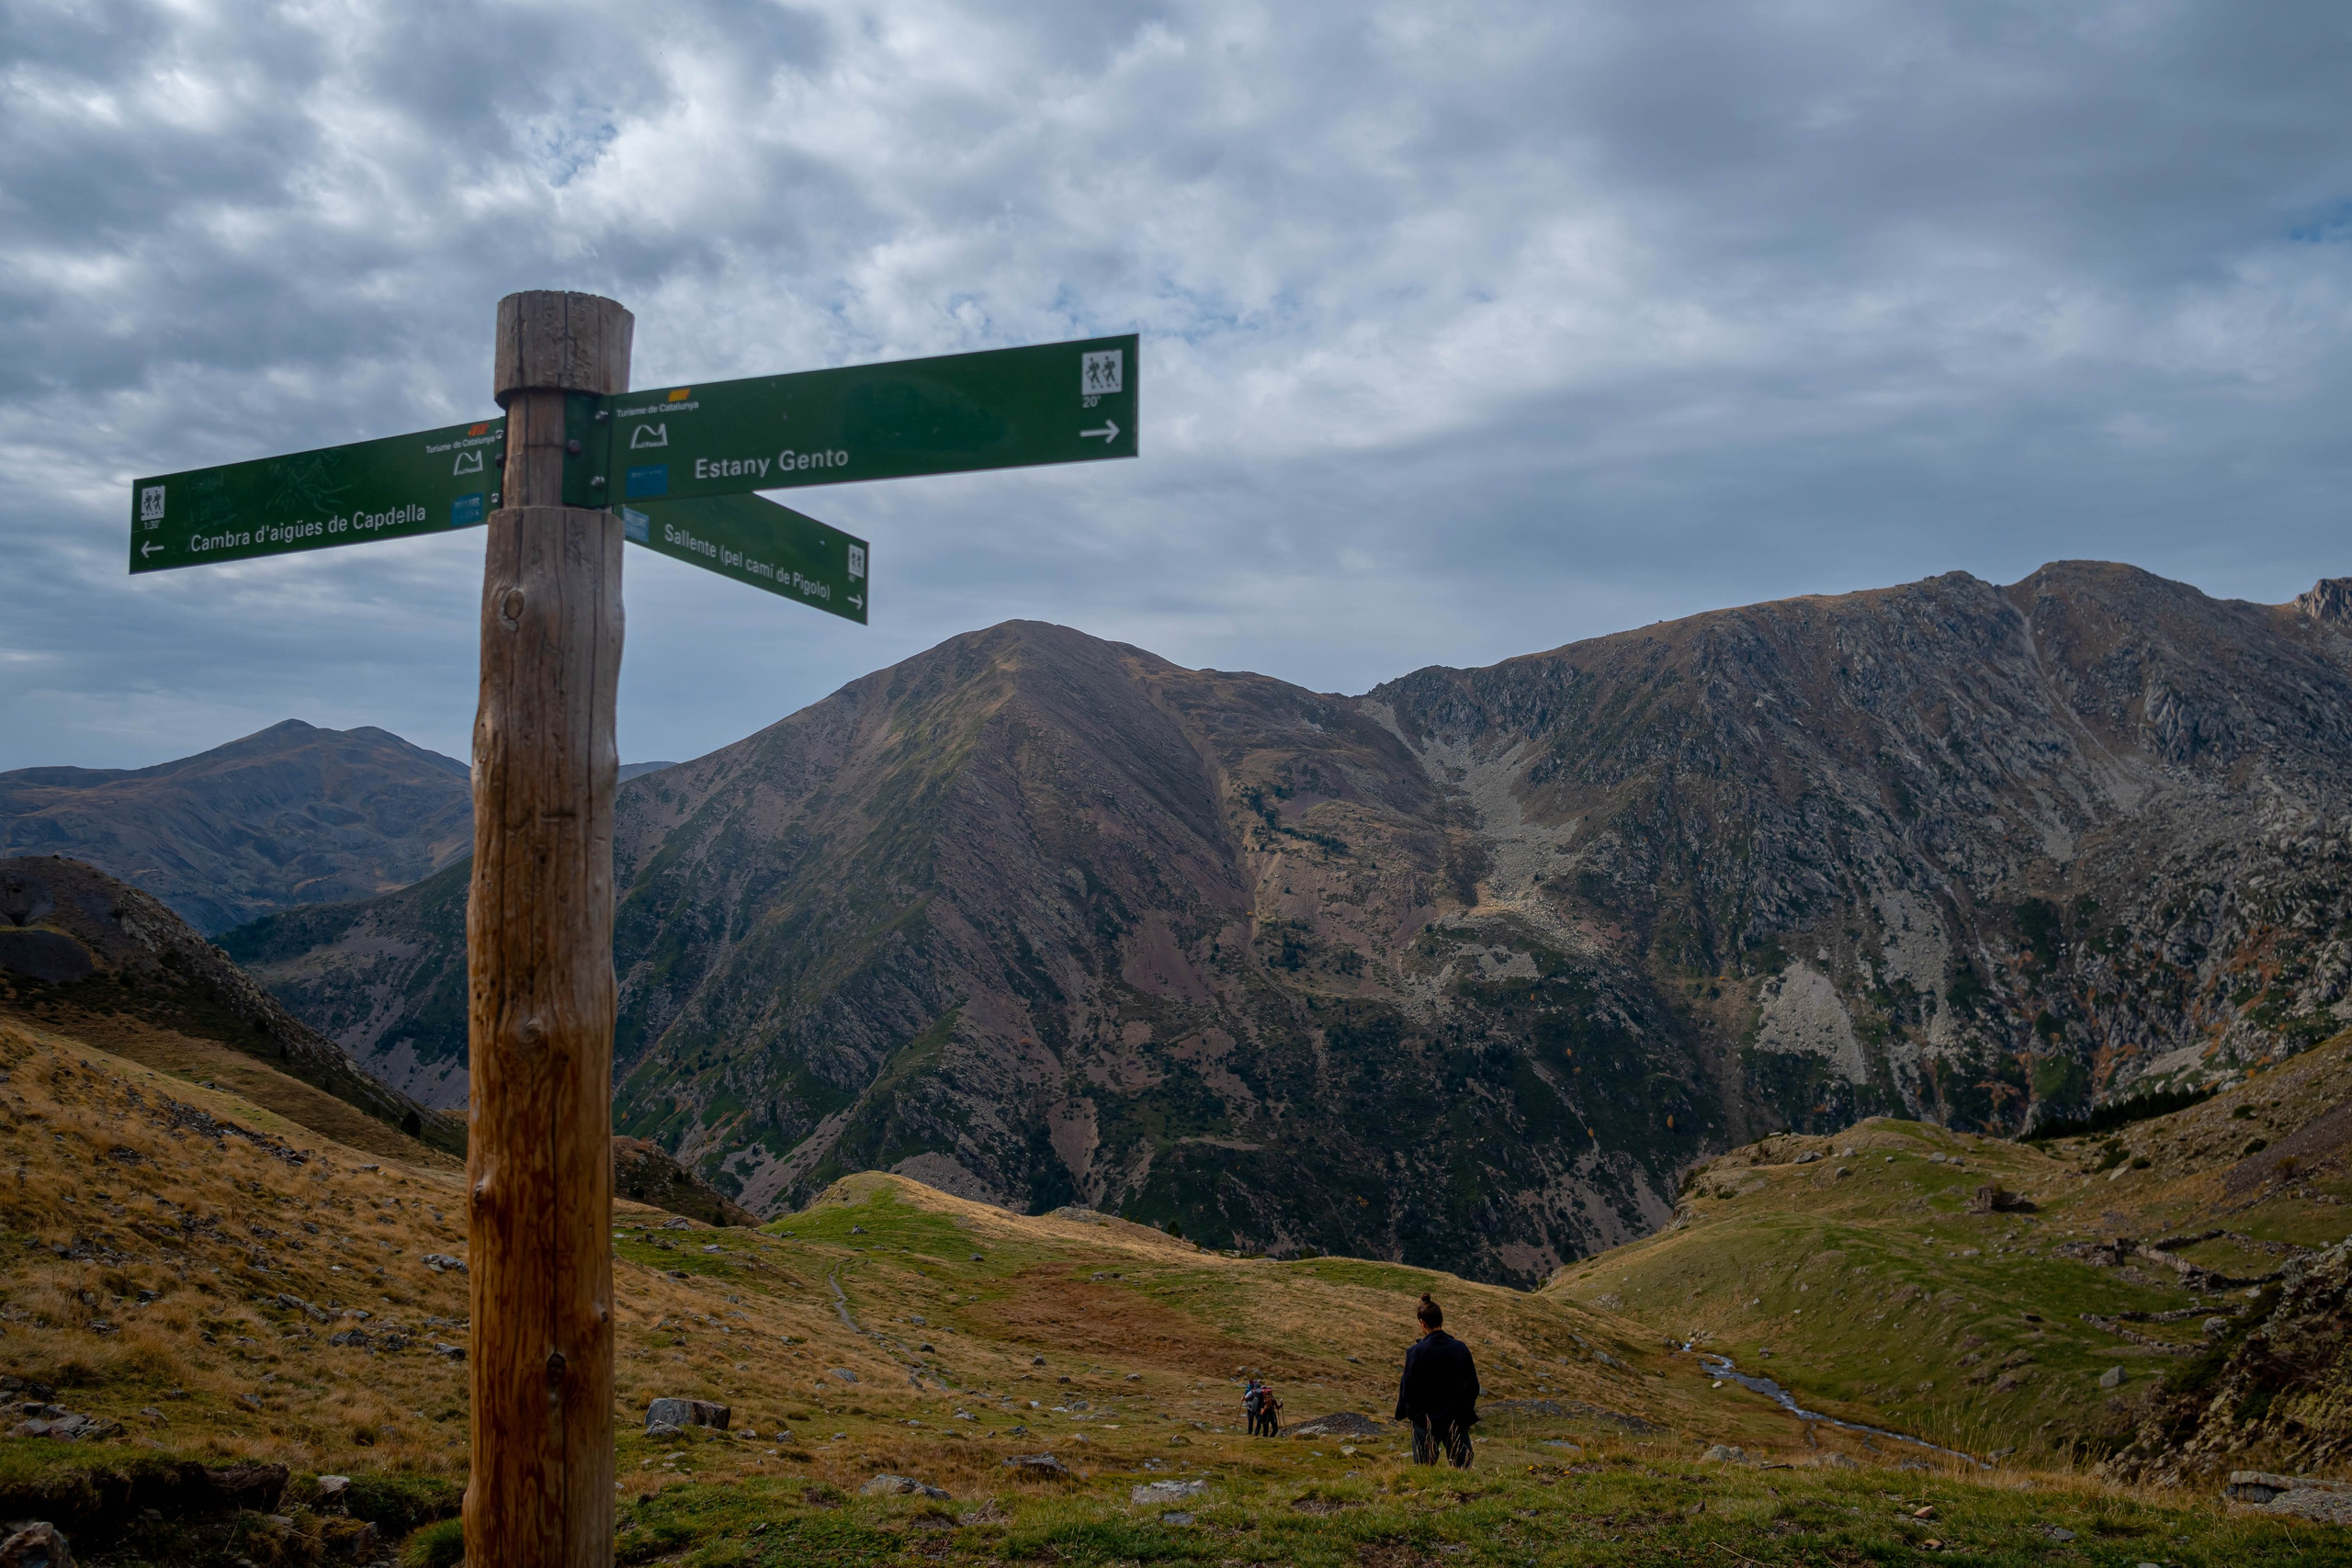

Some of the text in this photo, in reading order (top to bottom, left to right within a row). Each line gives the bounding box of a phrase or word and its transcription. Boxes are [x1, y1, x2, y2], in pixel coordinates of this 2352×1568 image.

[617, 401, 699, 418] Turisme de Catalunya
[425, 446, 452, 454] Turisme
[695, 449, 849, 479] Estany Gento
[190, 504, 426, 552] Cambra d'aigües de Capdella
[664, 524, 718, 558] Sallente
[719, 545, 743, 568] (pel
[745, 558, 775, 580] camí
[775, 567, 791, 585] de
[792, 571, 831, 602] Pigolo)
